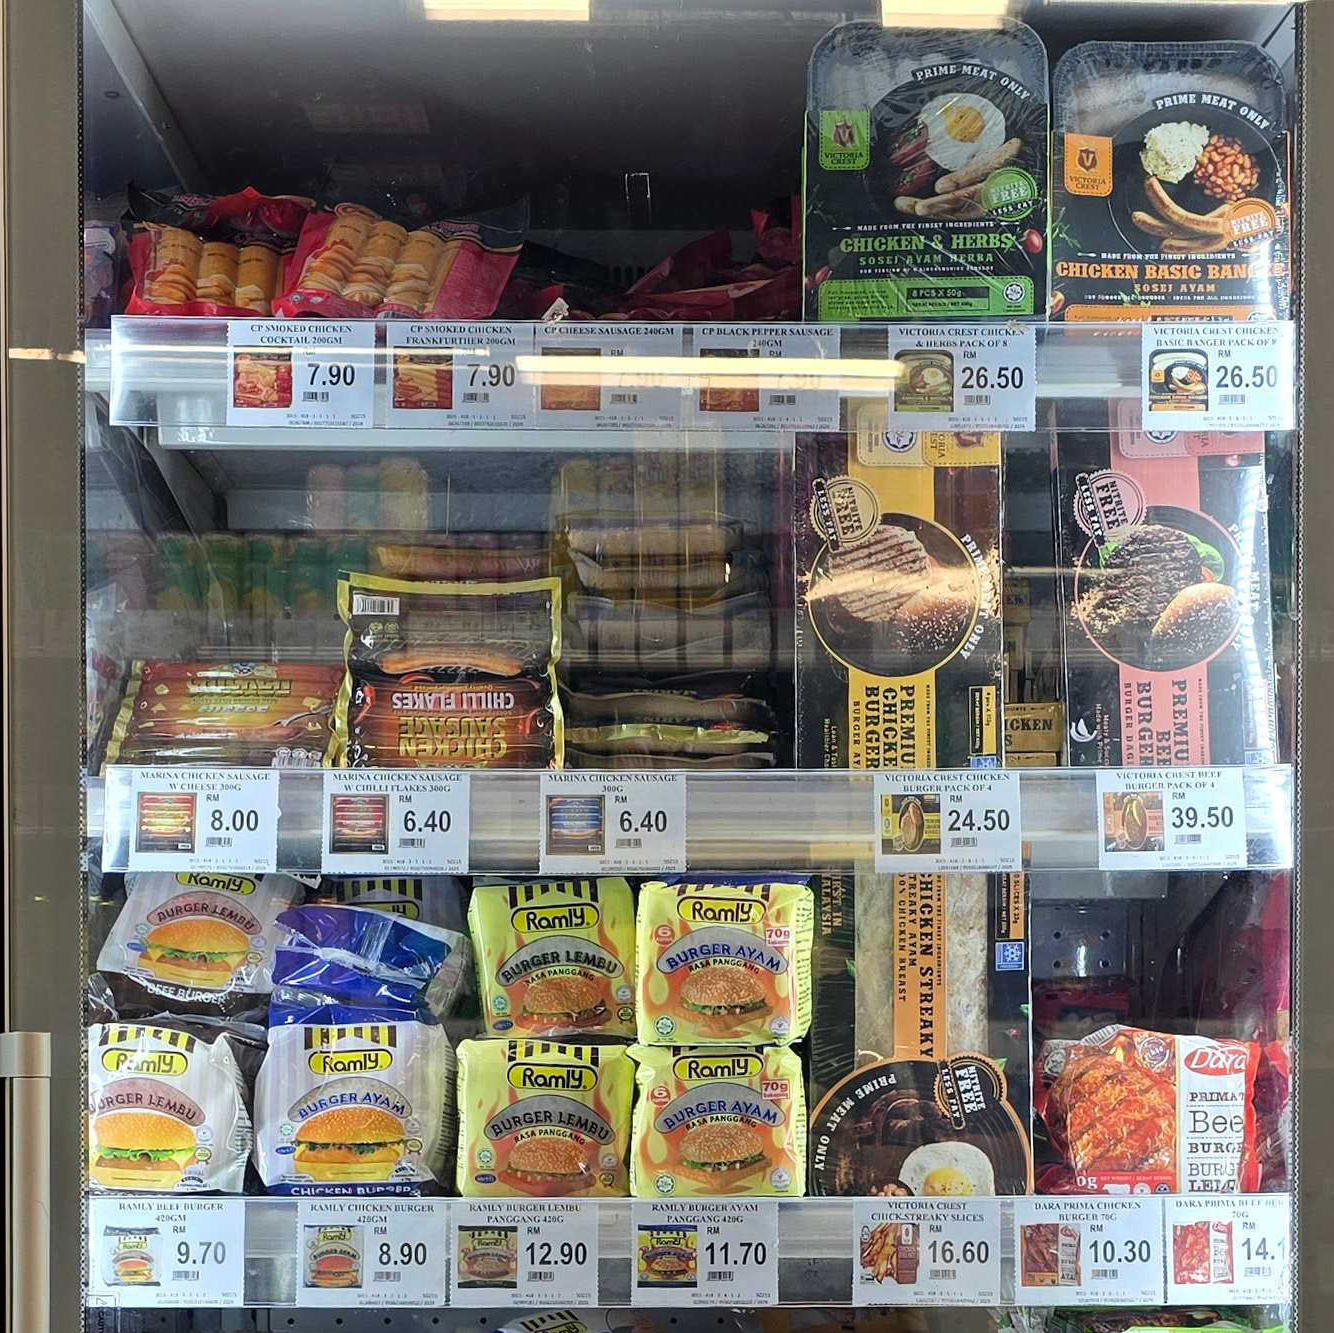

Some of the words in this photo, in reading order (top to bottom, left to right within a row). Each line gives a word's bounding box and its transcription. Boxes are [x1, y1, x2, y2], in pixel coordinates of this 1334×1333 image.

[859, 255, 901, 266] SOSEJ
[906, 254, 945, 265] AYAM
[950, 252, 993, 264] HERBA
[308, 364, 355, 386] 7.90
[961, 366, 1023, 390] 26.50
[1216, 365, 1278, 389] 26.50
[392, 693, 451, 710] FLAKES
[457, 693, 514, 710] CHILLI
[399, 717, 507, 737] SAUSAGE
[397, 737, 507, 756] CHICKEN
[211, 810, 259, 833] 8.00
[404, 810, 451, 833] 6.40
[948, 808, 1010, 831] 24.50
[1171, 806, 1233, 828] 39.50
[502, 950, 561, 983] BURGER
[564, 949, 619, 974] LEMBU
[664, 1102, 727, 1129] BURGER
[730, 1101, 778, 1125] AYAM
[469, 1204, 504, 1212] RAMLY
[505, 1204, 546, 1212] BURGER
[548, 1204, 582, 1212] LEMBU
[487, 1215, 540, 1224] PANGGANG
[542, 1215, 564, 1224] 420G
[177, 1242, 226, 1264] 9.70
[379, 1243, 427, 1265] 8.90
[526, 1242, 587, 1265] 12.90
[705, 1242, 766, 1265] 11.70
[928, 1241, 989, 1263] 16.60
[1089, 1241, 1150, 1263] 10.30
